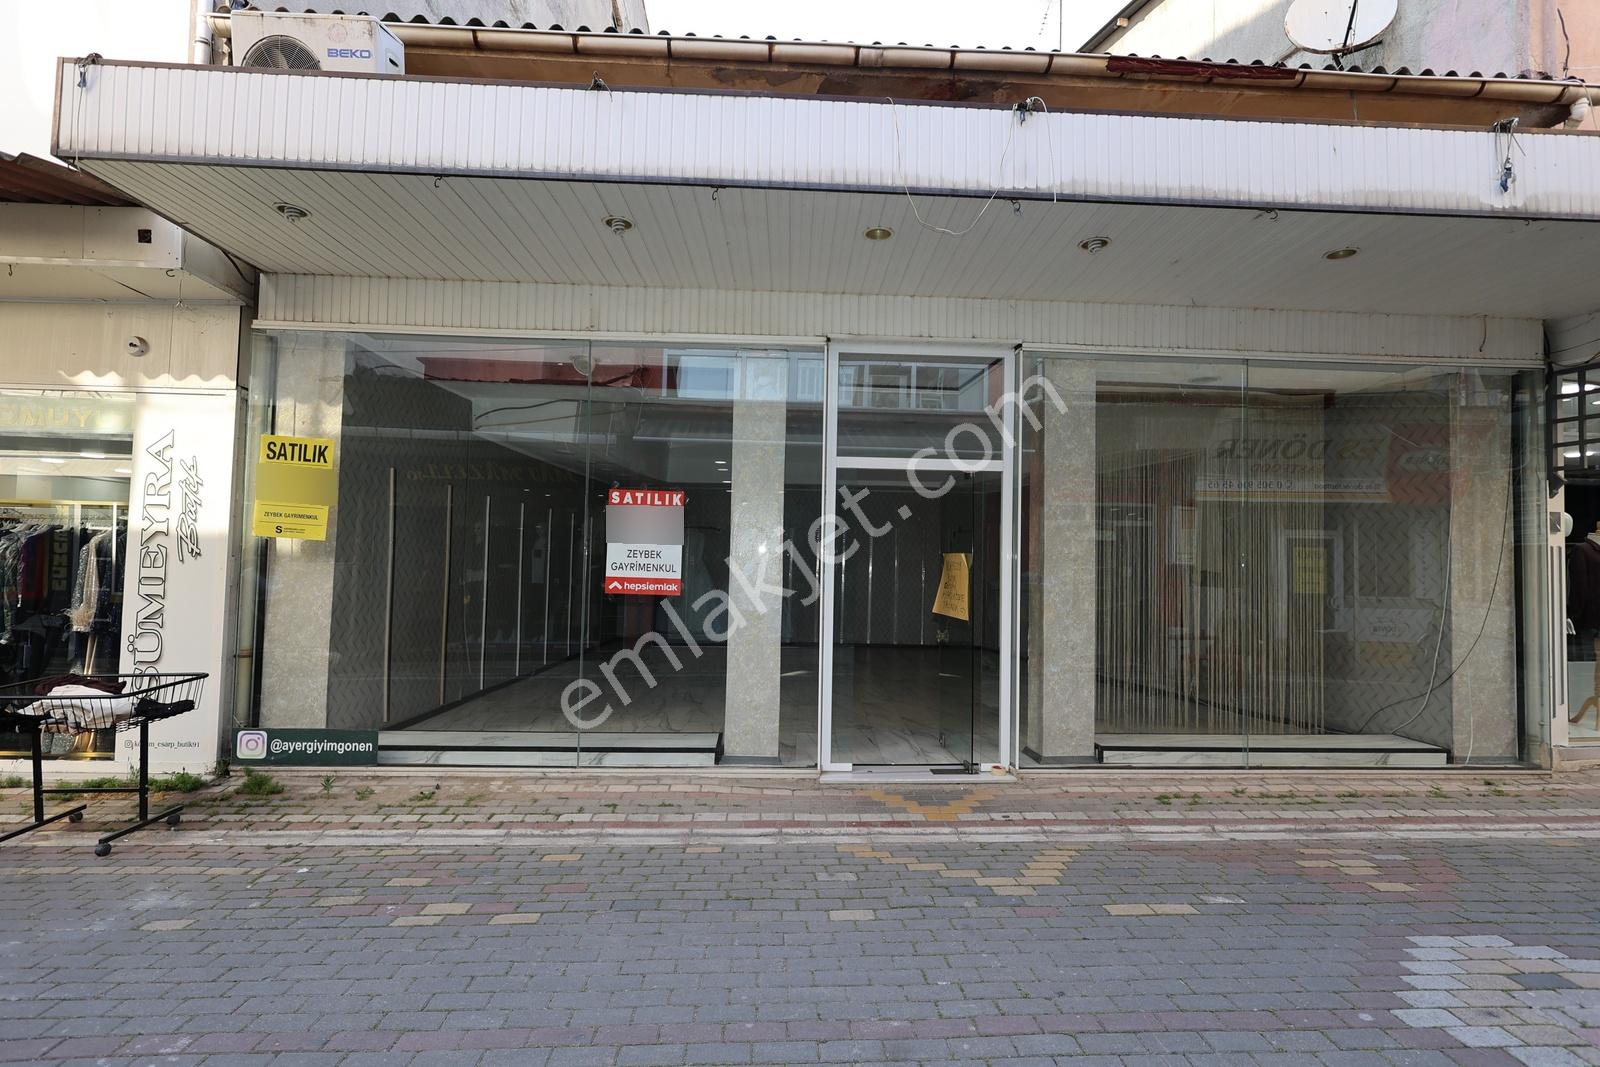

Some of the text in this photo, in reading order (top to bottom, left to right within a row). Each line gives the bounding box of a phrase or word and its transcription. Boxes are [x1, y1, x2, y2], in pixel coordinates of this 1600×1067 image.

[327, 48, 372, 59] BEKO
[266, 441, 329, 463] SATILIK
[612, 492, 682, 506] SATILIK
[177, 456, 205, 563] Butik
[275, 525, 283, 534] S
[627, 549, 662, 559] ZEYBEK
[127, 428, 175, 700] SÜMEYRA
[610, 561, 676, 573] GAYRİMENKUL
[624, 581, 678, 592] hepsiemlak
[270, 738, 373, 754] @ayergiyimgonen
